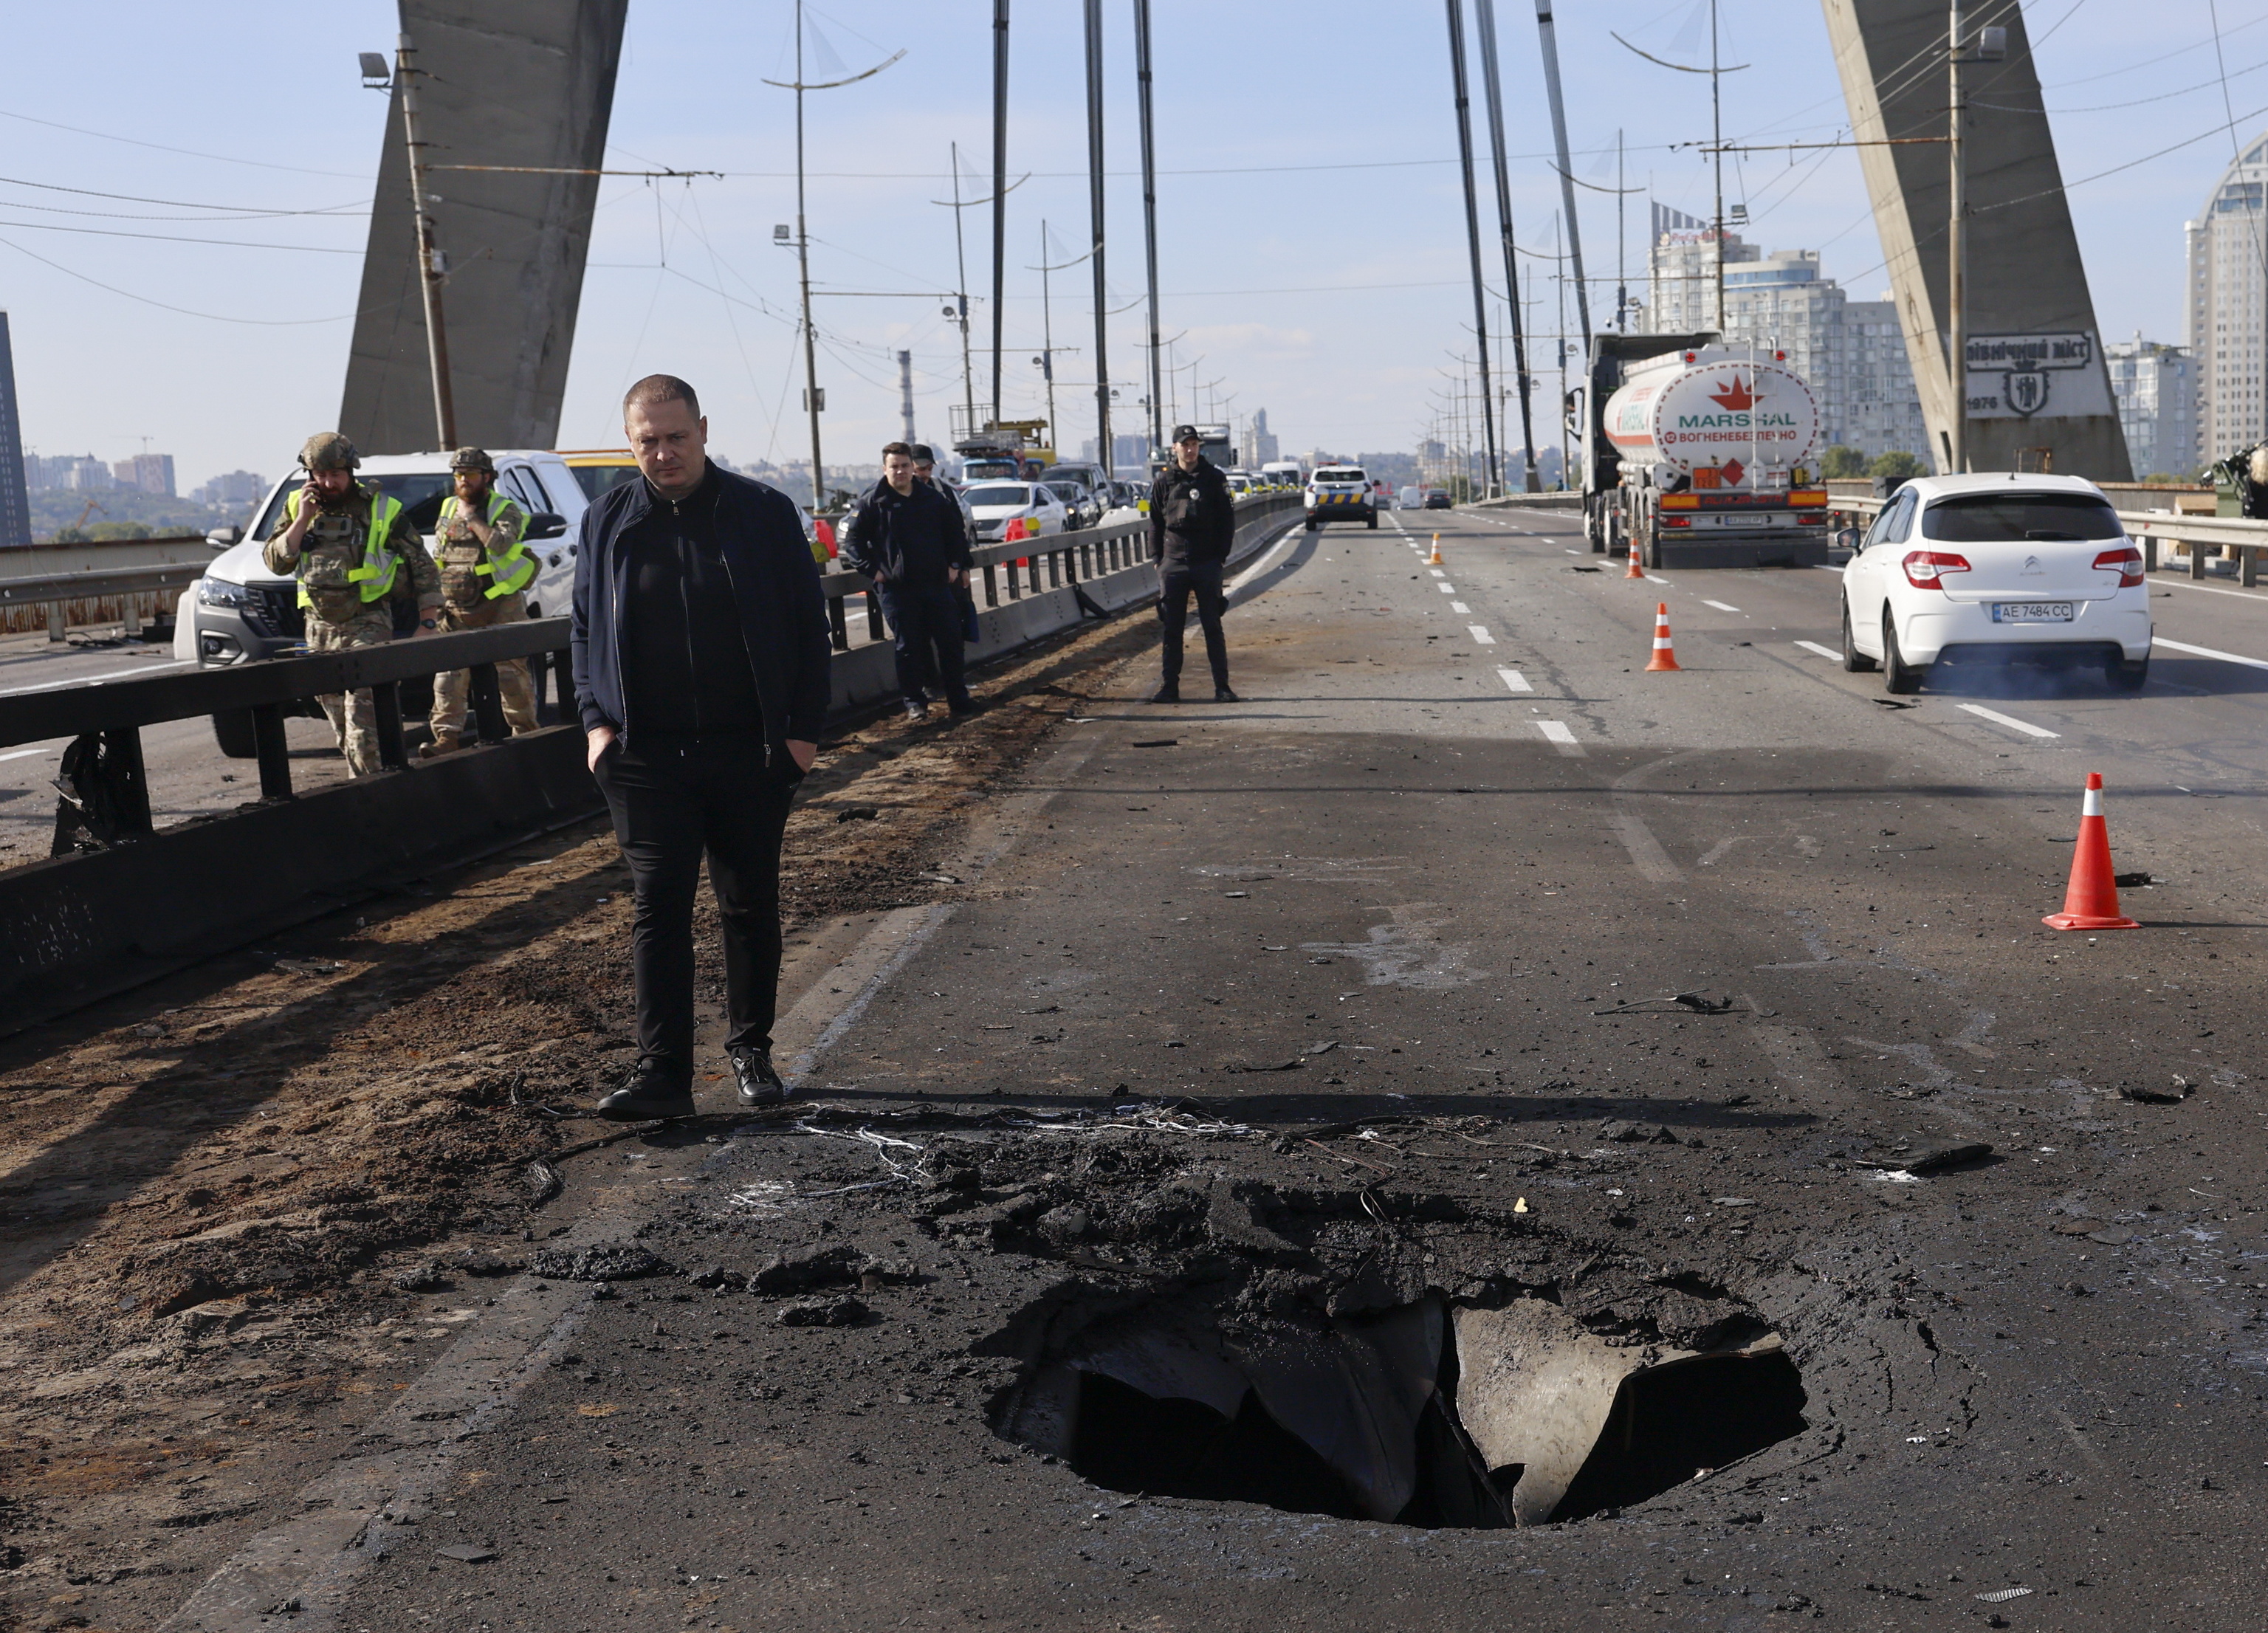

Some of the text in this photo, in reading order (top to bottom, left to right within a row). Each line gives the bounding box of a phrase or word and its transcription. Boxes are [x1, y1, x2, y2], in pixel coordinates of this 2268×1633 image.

[2003, 605, 2069, 617] AE 7484 CC
